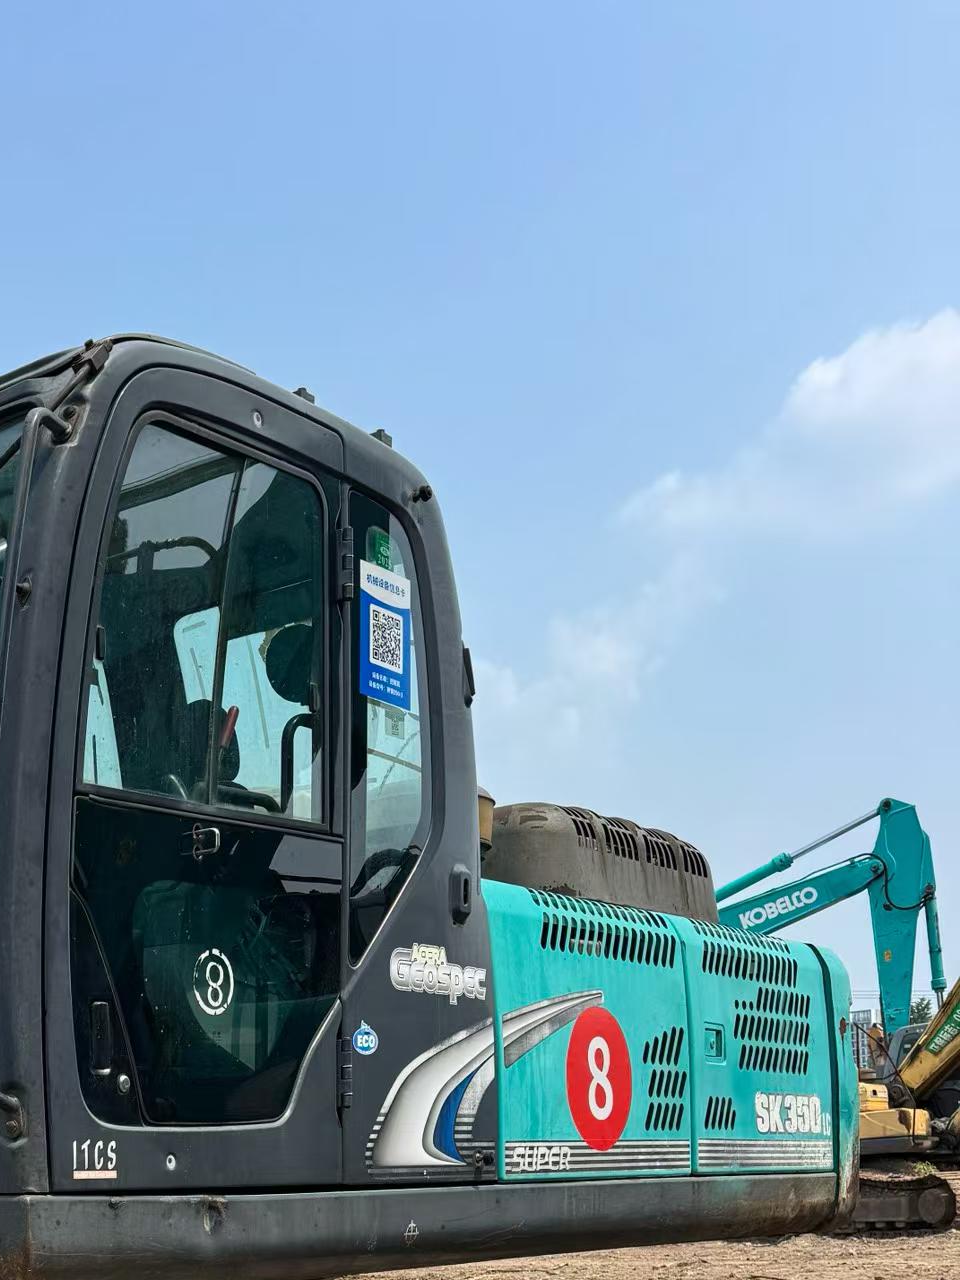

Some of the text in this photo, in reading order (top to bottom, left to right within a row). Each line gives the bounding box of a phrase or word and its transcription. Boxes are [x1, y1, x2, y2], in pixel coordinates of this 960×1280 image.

[738, 886, 818, 930] KOBELCO
[206, 961, 224, 1007] 8
[357, 1034, 376, 1048] ECO
[588, 1036, 614, 1121] 8
[754, 1091, 821, 1134] SK350
[72, 1138, 117, 1170] ITCS
[512, 1146, 571, 1172] SUPER
